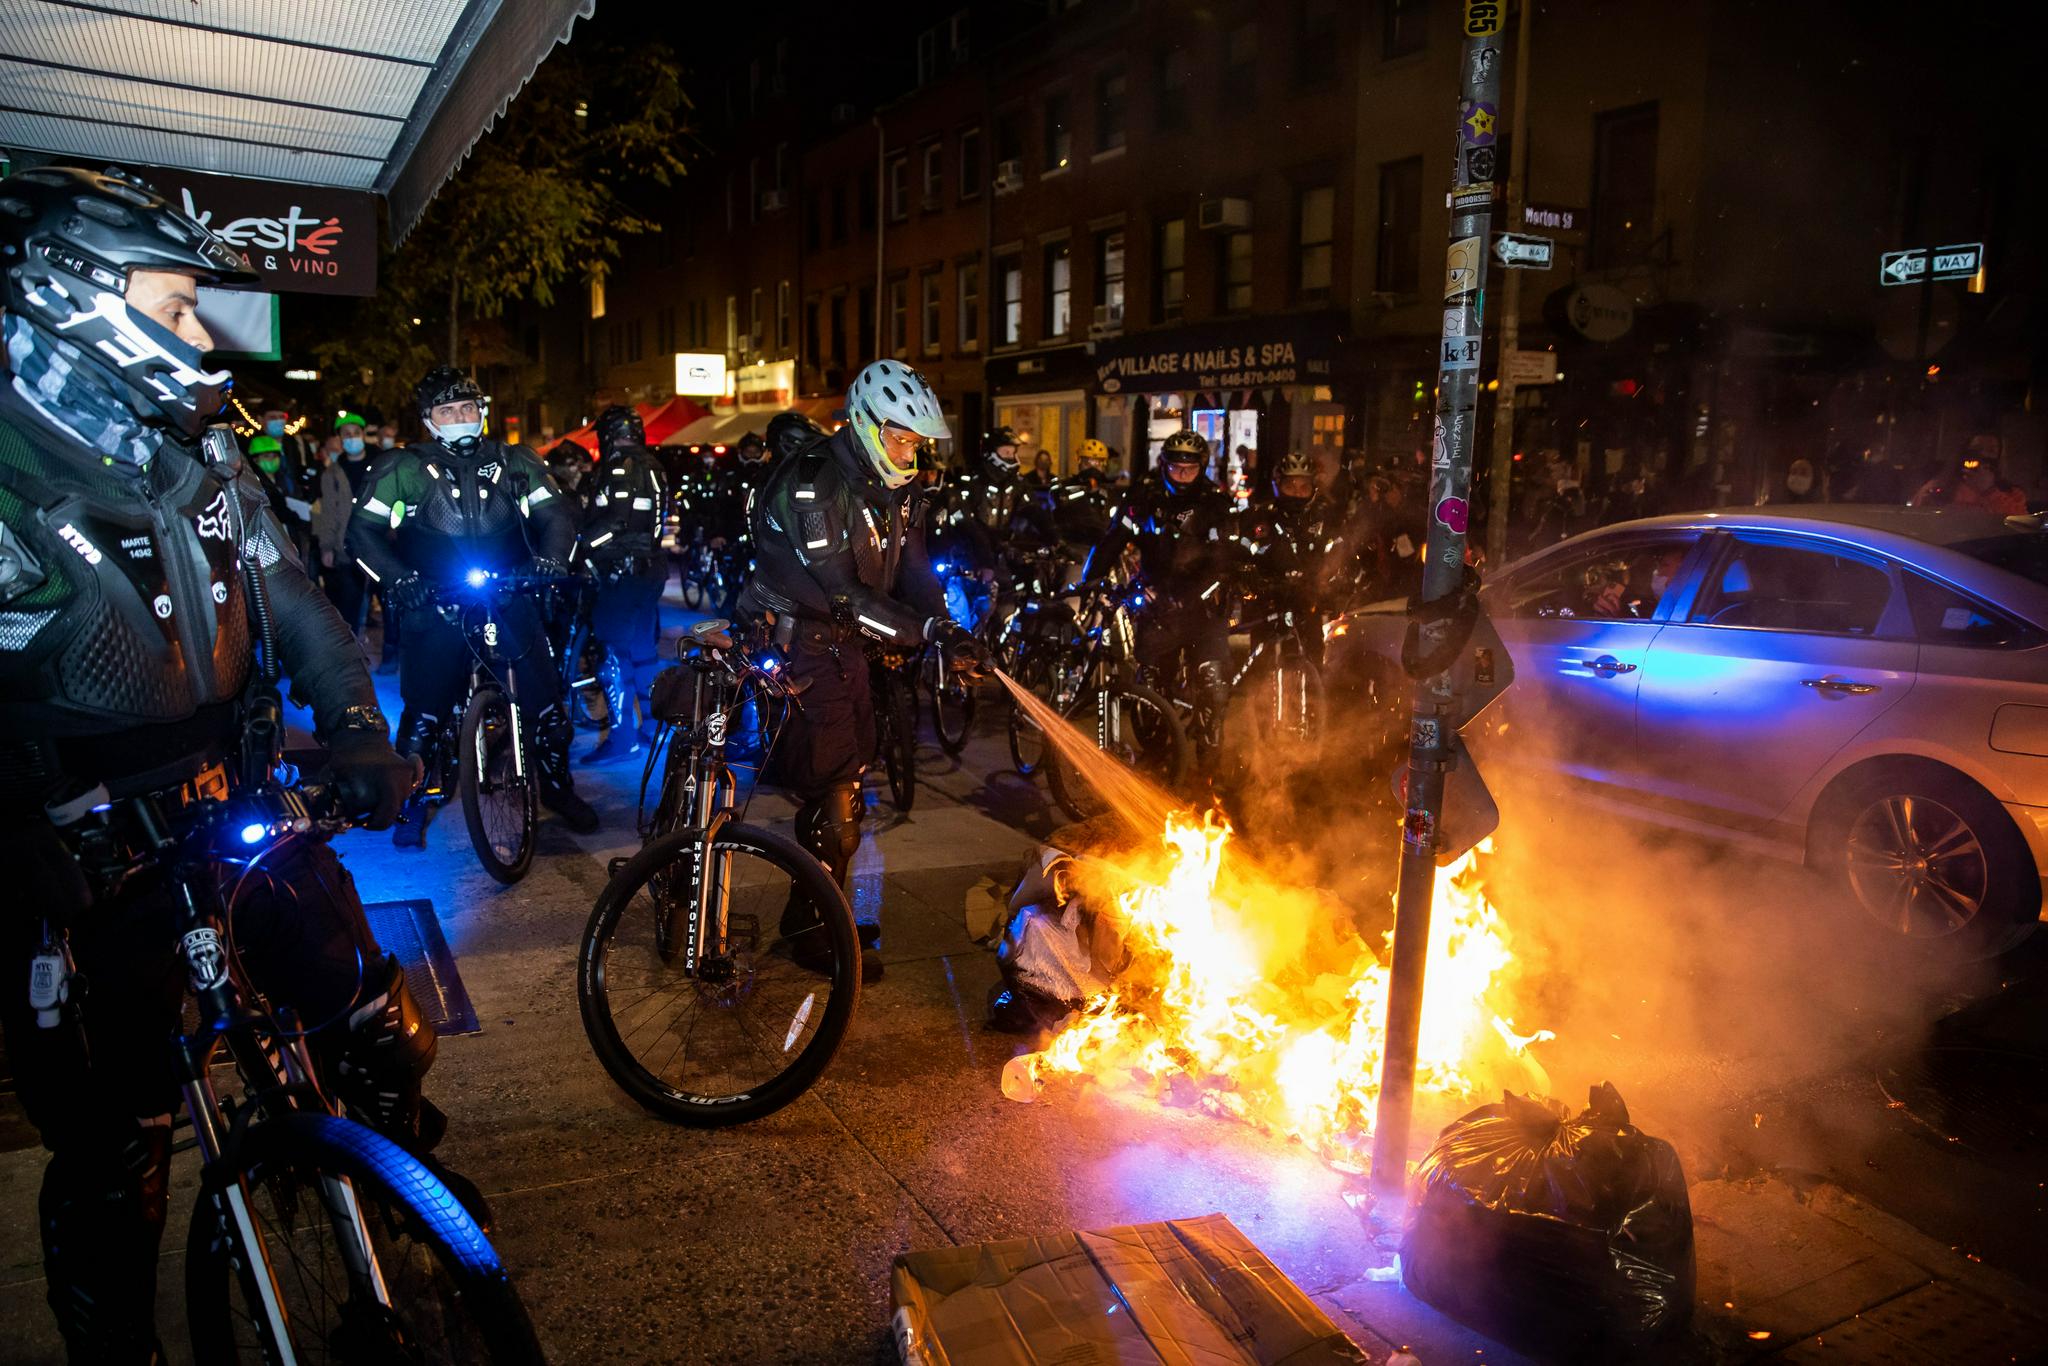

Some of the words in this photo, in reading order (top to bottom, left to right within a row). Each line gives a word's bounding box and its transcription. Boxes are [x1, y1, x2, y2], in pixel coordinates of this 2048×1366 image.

[1525, 207, 1560, 228] Morton
[1562, 212, 1573, 230] St
[1528, 247, 1546, 259] WAY
[1895, 259, 1923, 273] ONE
[1938, 255, 1970, 269] WAY
[264, 255, 278, 270] &
[289, 257, 338, 276] VINO
[1118, 353, 1178, 376] VILLAGE
[1182, 352, 1190, 372] 4
[1194, 348, 1240, 371] NAILS
[1244, 346, 1256, 367] &
[1261, 342, 1295, 365] SPA
[58, 523, 102, 565] NYPD
[121, 537, 149, 549] MARTE
[691, 841, 702, 886] NYPD
[686, 900, 697, 969] POLICE
[35, 962, 53, 971] NYC
